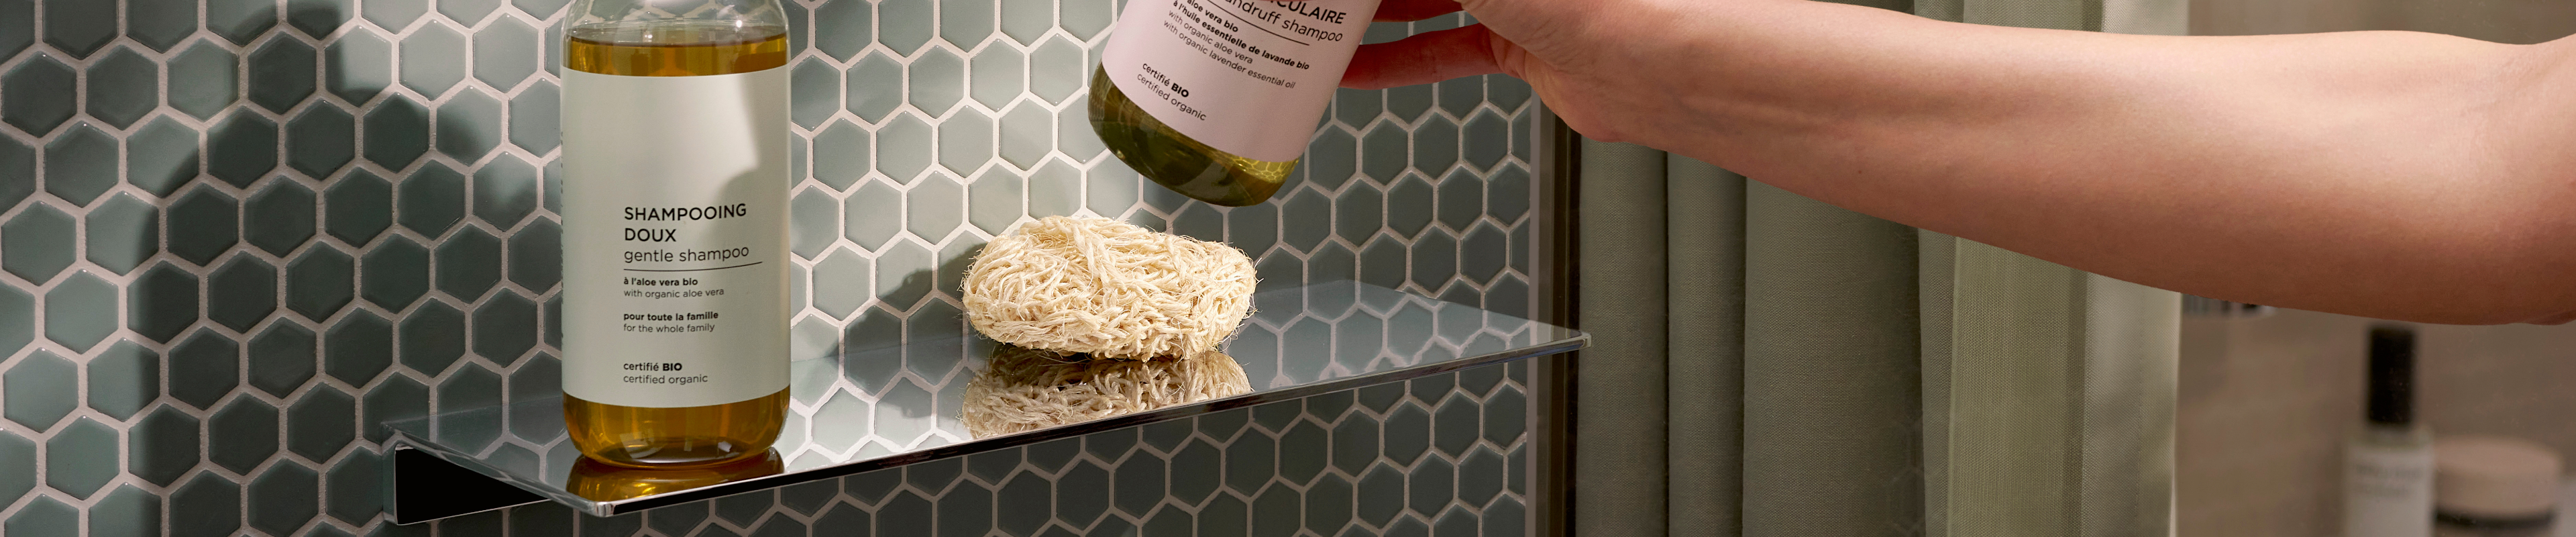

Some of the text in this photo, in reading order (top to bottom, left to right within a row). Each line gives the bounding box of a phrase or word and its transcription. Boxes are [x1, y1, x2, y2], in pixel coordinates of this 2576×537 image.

[1205, 9, 1222, 24] vera
[1224, 20, 1238, 32] bio
[1271, 1, 1346, 24] ULAIRE
[1169, 10, 1253, 64] with organic aloe vera
[1179, 3, 1201, 23] l'huile
[1201, 21, 1247, 49] essentielle
[1248, 46, 1260, 55] de
[1262, 50, 1295, 67] lavande
[1296, 61, 1309, 70] bio
[1281, 19, 1343, 42] shampoo
[1164, 20, 1178, 35] with
[1179, 32, 1208, 54] organic
[1209, 50, 1246, 73] lavender
[1247, 69, 1285, 87] essential
[1142, 63, 1189, 97] certifié BIO
[1137, 74, 1207, 121] certified organic
[625, 203, 747, 221] SHAMPOOING
[625, 228, 677, 242] DOUX
[624, 247, 749, 263] gentle shampoo
[624, 277, 629, 285] à
[631, 277, 657, 286] l'aloe
[624, 289, 643, 297] with
[645, 290, 680, 299] organic
[683, 289, 703, 297] aloe
[676, 313, 684, 321] la
[687, 311, 719, 320] famille
[624, 324, 636, 332] for
[656, 325, 684, 333] whole
[687, 324, 715, 332] family
[623, 362, 683, 371] certifié BIO
[623, 374, 708, 385] certified organic
